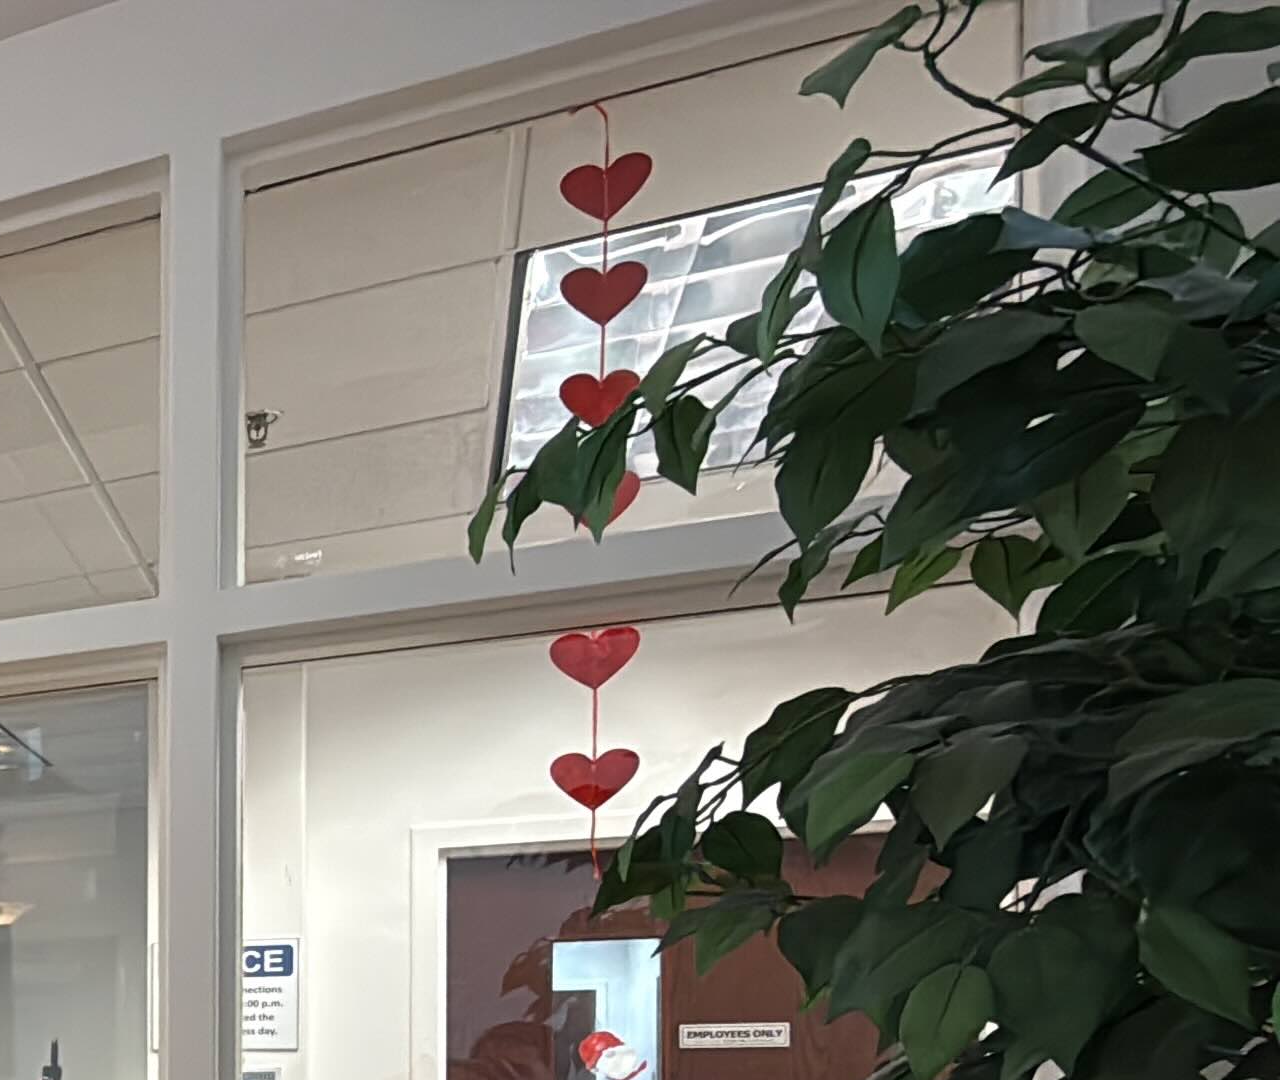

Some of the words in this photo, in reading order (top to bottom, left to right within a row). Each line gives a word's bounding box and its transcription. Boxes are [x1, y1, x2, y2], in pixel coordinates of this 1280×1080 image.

[258, 1013, 275, 1021] the
[687, 1030, 750, 1039] EMPLOYEES
[752, 1029, 783, 1038] ONLY
